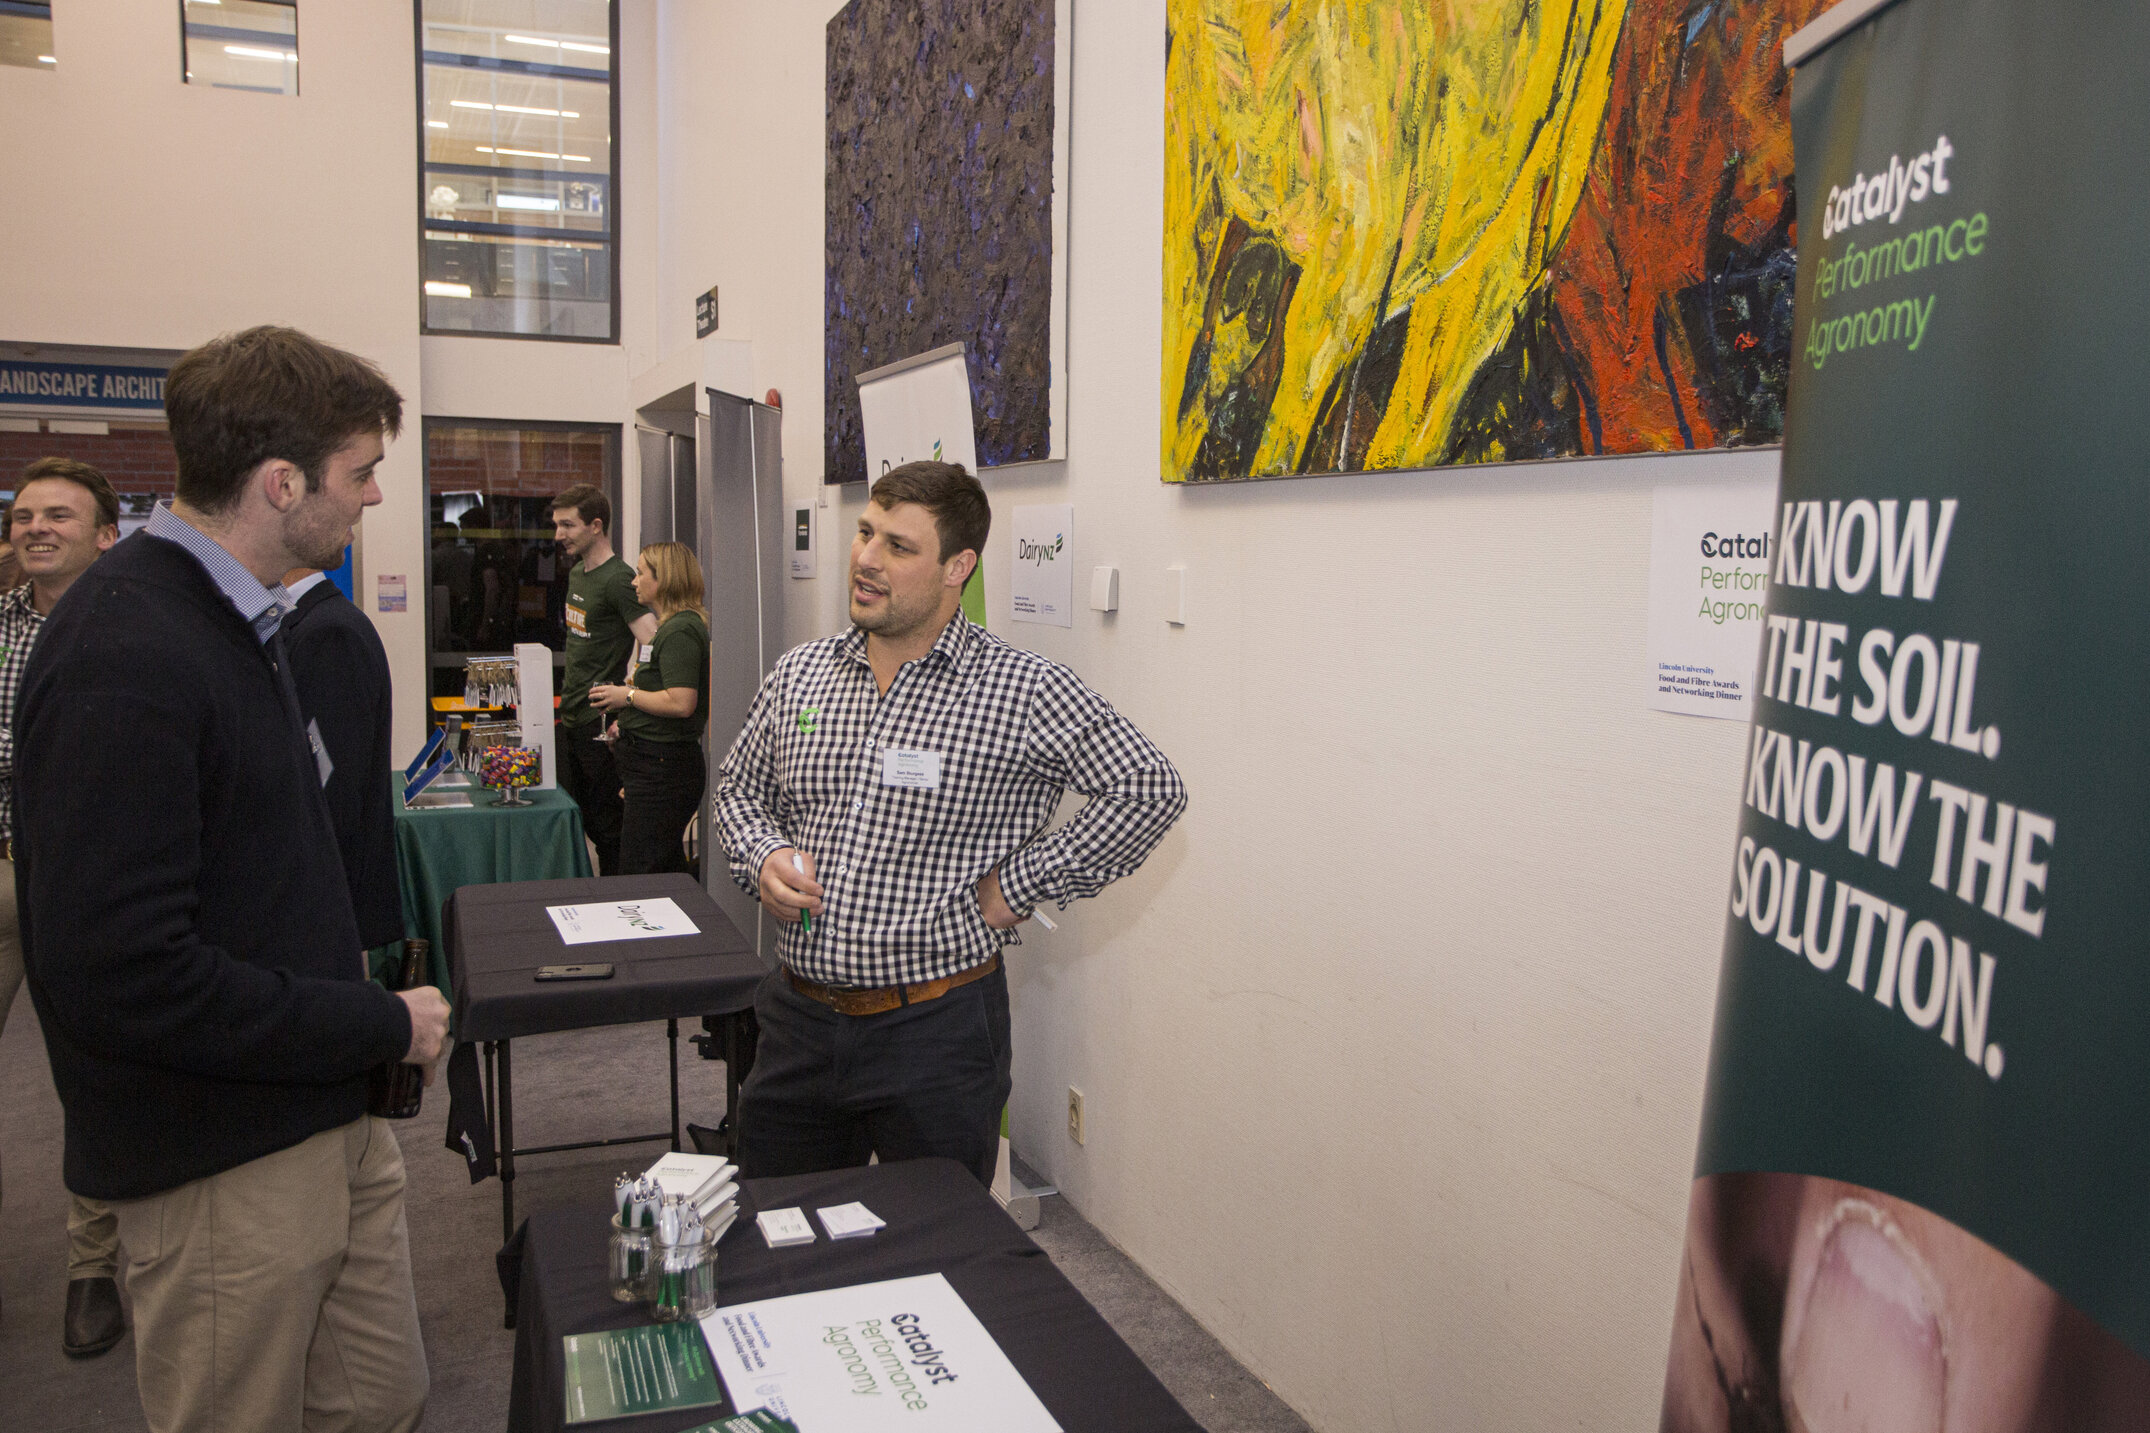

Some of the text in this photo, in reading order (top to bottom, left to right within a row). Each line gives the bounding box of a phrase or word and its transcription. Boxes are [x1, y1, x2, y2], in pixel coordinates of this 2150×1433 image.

[1823, 135, 1953, 239] Catalyst
[1813, 212, 1988, 303] Performance
[1803, 294, 1935, 369] Agronomy
[0, 369, 167, 400] ANDSCAPE ARCHIT
[1020, 539, 1054, 567] DairyNZ
[1701, 532, 1771, 558] Catal
[1774, 499, 1958, 600] KNOW
[1659, 663, 1714, 675] Lincoln University
[1659, 674, 1739, 689] Food and Fibre Awards
[1673, 686, 1714, 699] Networking
[1716, 690, 1743, 700] Dinner
[1763, 614, 2000, 760] THE SOIL.
[1746, 725, 2055, 938] KNOW THE
[1732, 836, 2004, 1080] SOLUTION.
[823, 1326, 882, 1395] Agronomy
[856, 1319, 928, 1410] Performance
[891, 1313, 958, 1385] Catalyst
